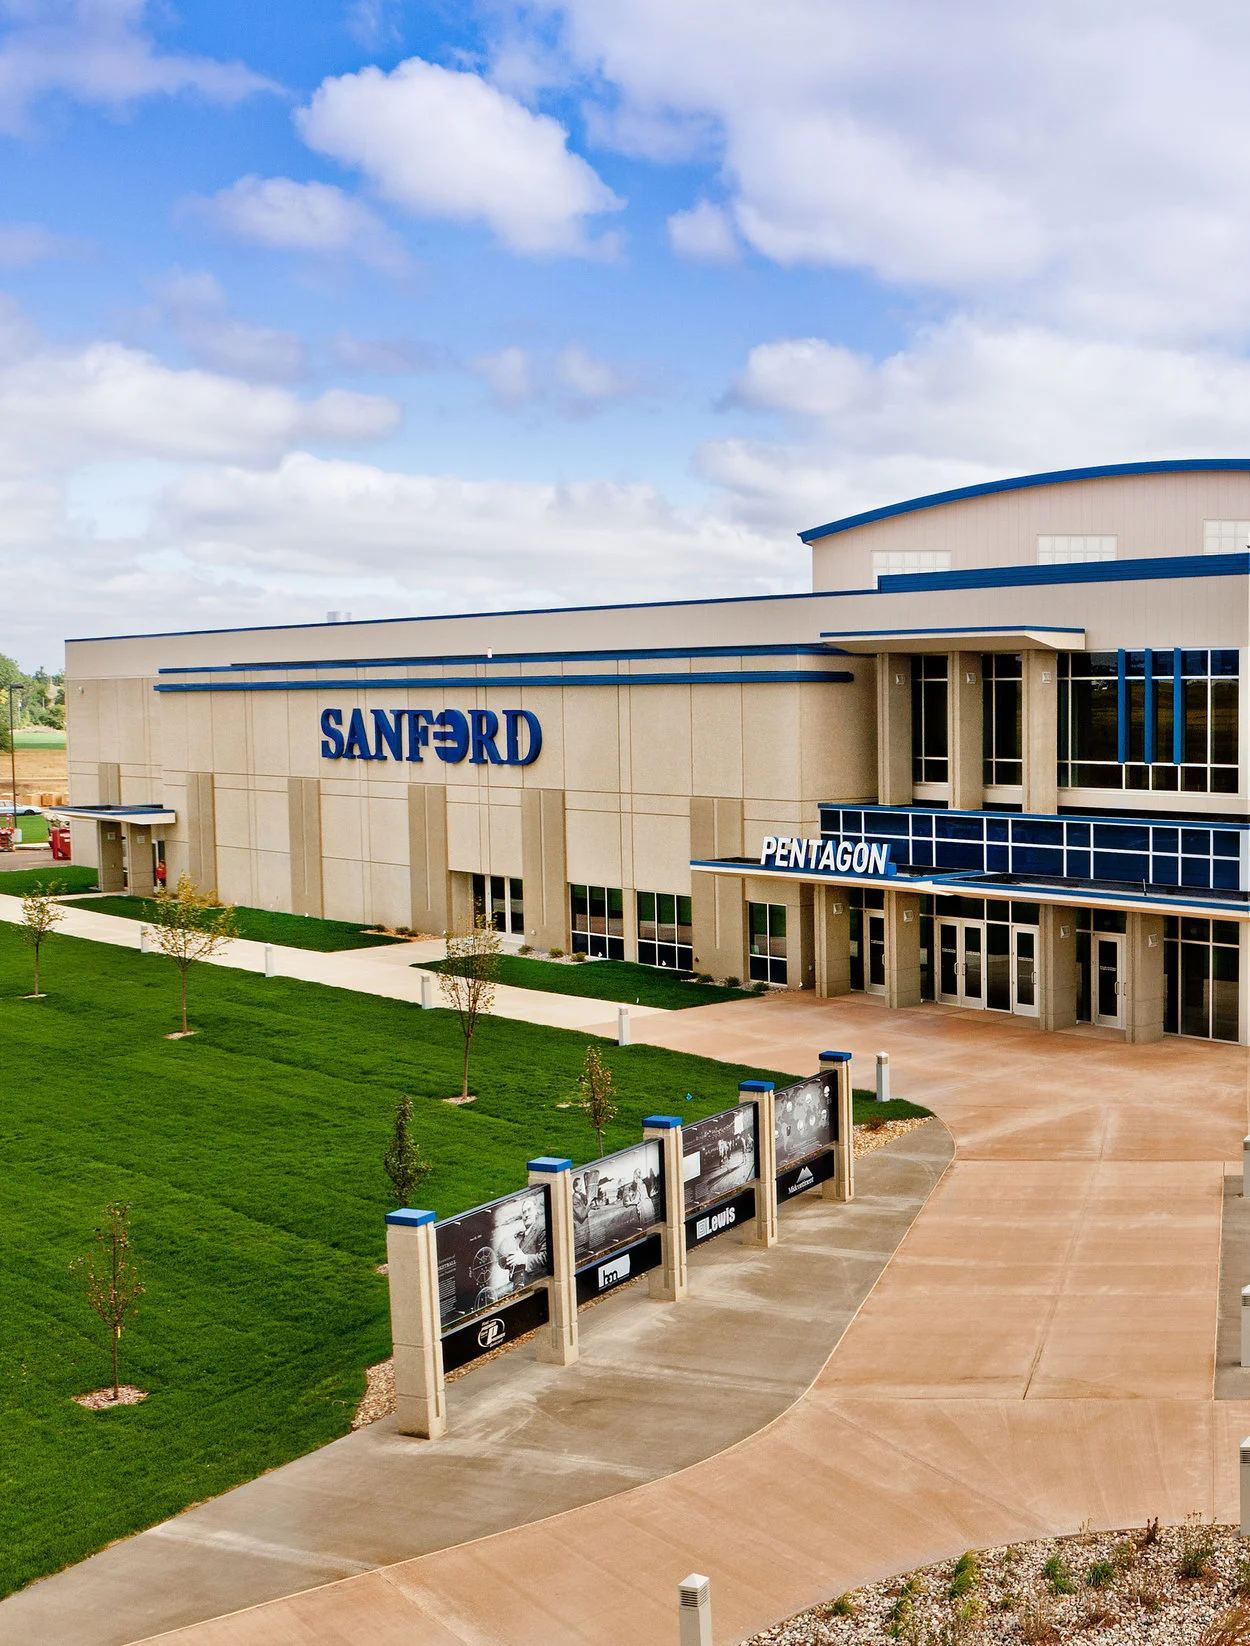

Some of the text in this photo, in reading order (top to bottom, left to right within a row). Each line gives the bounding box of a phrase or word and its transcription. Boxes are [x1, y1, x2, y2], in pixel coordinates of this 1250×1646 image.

[320, 708, 543, 766] SANFORD
[760, 836, 892, 875] PENTAGON
[706, 1207, 736, 1235] Lewis
